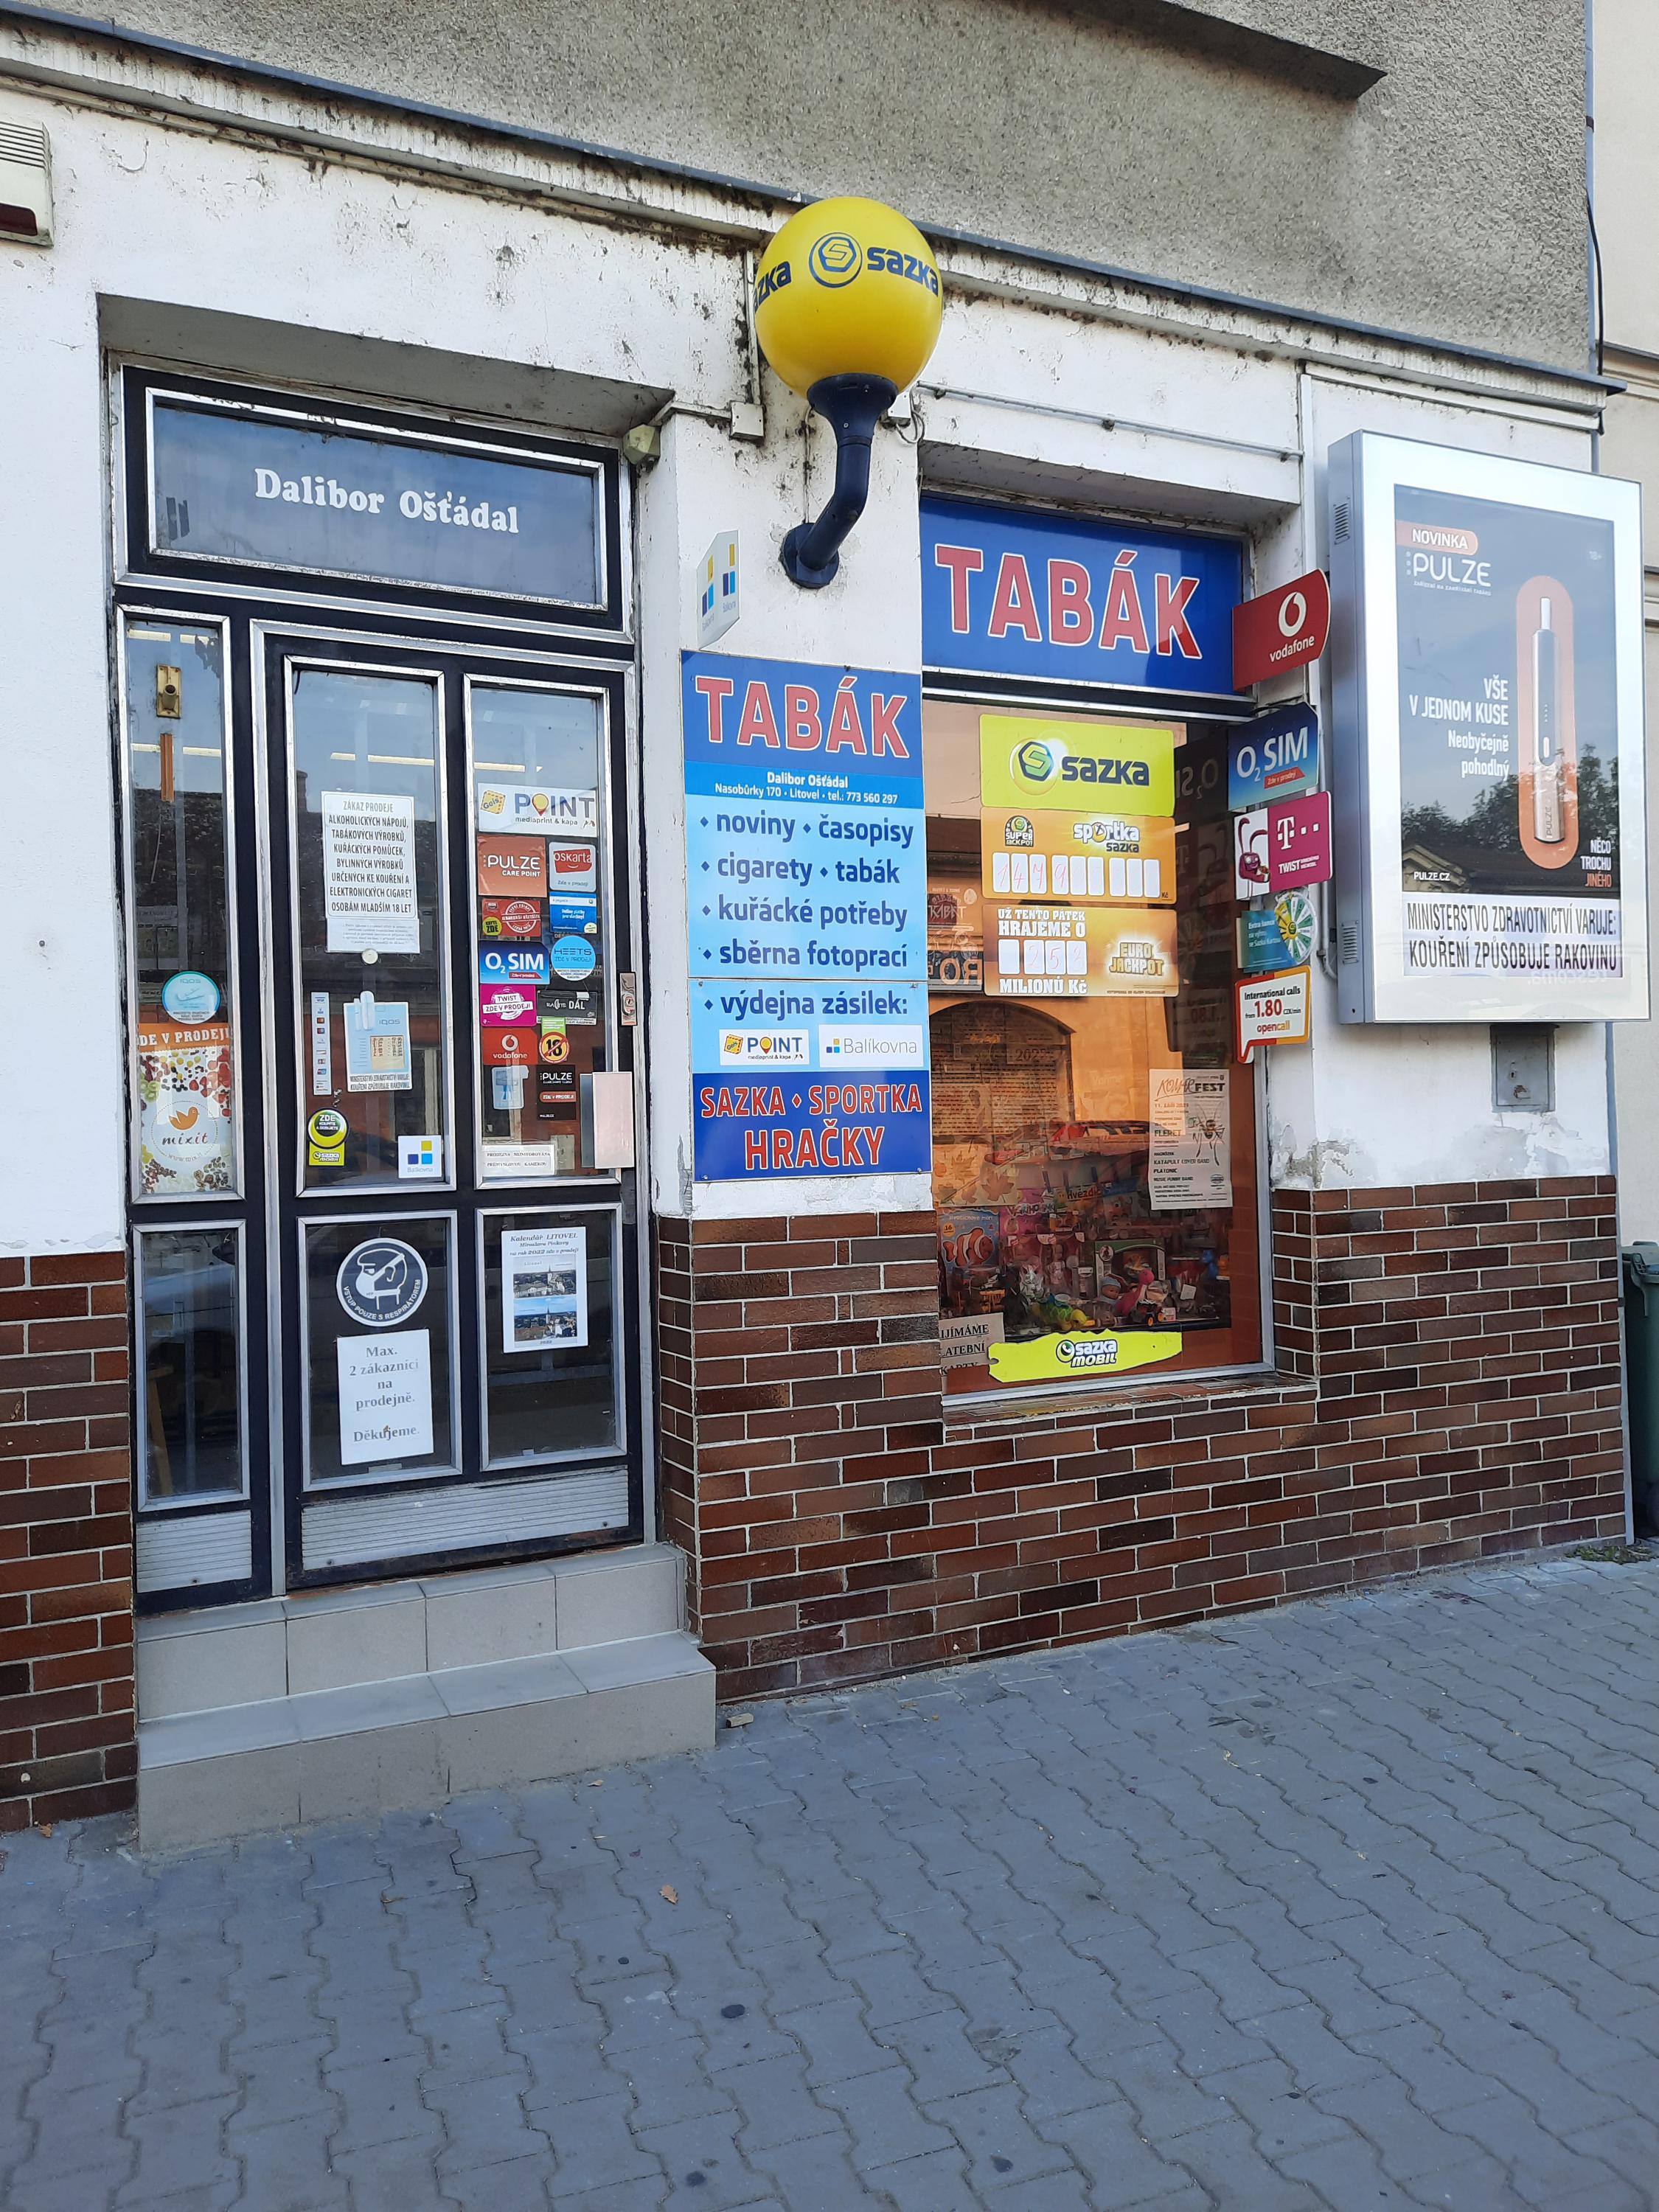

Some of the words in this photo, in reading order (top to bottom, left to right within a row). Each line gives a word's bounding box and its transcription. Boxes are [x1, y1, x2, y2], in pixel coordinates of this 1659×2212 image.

[254, 467, 385, 515] Dalibor
[399, 490, 519, 534] Ošťádal
[1412, 529, 1468, 549] NOVINKA
[1413, 552, 1492, 587] PULZE
[934, 543, 1203, 659] TABÁK
[1270, 636, 1315, 662] vodafone
[1484, 674, 1509, 700] VŠE
[695, 675, 910, 758] TABÁK
[1409, 695, 1419, 716] V
[1422, 697, 1472, 722] JEDNOM
[1475, 703, 1509, 726] KUSE
[1264, 726, 1308, 771] SIM
[1448, 730, 1509, 755] Neobyčejně
[1461, 758, 1509, 778] pohodlný
[767, 771, 807, 786] Dalibor
[808, 774, 848, 788] Ošťádal
[715, 783, 764, 799] Nasobůrky
[766, 786, 782, 797] 170
[790, 789, 819, 800] Litovel
[846, 792, 861, 801] 773
[863, 793, 880, 803] 560
[882, 793, 898, 804] 297
[344, 801, 364, 811] ZÁKAZ
[366, 802, 394, 813] PRODEJE
[328, 815, 380, 827] ALKOHOLICKÝCH
[716, 809, 796, 843] noviny
[818, 813, 914, 849] časopisy
[332, 829, 373, 841] TABÁKOVÝCH
[333, 843, 371, 854] KUŘÁCKÝCH
[1590, 836, 1611, 854] NĚCO
[336, 858, 372, 869] BYLINNÝCH
[374, 859, 403, 869] VÝROBKŮ
[487, 855, 540, 870] PULZE
[717, 851, 813, 886] cigarety
[835, 857, 900, 884] tabák
[1279, 859, 1301, 874] TWIST
[1580, 855, 1612, 871] TROCHU
[332, 872, 365, 883] URČENÝCH
[366, 874, 375, 883] KE
[376, 874, 404, 883] KOUŘENÍ
[1413, 871, 1451, 881] PULZE.CZ
[1585, 873, 1612, 888] JINÉHO
[330, 886, 384, 897] ELEKTRONICKÝCH
[386, 888, 411, 898] CIGARET
[332, 901, 359, 911] OSOBÁM
[361, 902, 391, 912] MLADŠÍM
[393, 904, 400, 912] 18
[401, 904, 411, 913] LET
[719, 894, 813, 922] kuřácké
[820, 900, 908, 932] potřeby
[998, 907, 1012, 919] UŽ
[1015, 909, 1050, 920] TENTO
[1052, 908, 1085, 921] PÁTEK
[1408, 902, 1489, 932] MINISTERSTVO
[1492, 902, 1573, 935] ZDRAVOTNICTVÍ
[1576, 909, 1616, 935] VARUJE:
[998, 920, 1071, 936] HRAJEME
[1076, 922, 1085, 937] O
[720, 938, 800, 965] sběrna
[807, 939, 908, 972] fotoprací
[1119, 942, 1153, 958] EURO
[1410, 935, 1470, 968] KOUŘENÍ
[1475, 936, 1550, 969] ZPŮSOBUJE
[1555, 944, 1617, 971] RAKOVINU
[507, 953, 543, 970] SIM
[1109, 956, 1164, 976] JACKPOT
[1000, 975, 1063, 993] MILIONŮ
[1068, 979, 1087, 994] Kč
[1245, 987, 1285, 1000] International
[1286, 986, 1301, 995] calls
[720, 989, 814, 1021] výdejna
[821, 990, 908, 1015] zásilek:
[1254, 999, 1282, 1018] 1.80
[1257, 1020, 1290, 1034] opencall
[161, 1033, 170, 1044] V
[844, 1037, 917, 1054] Balíkovna
[543, 1072, 572, 1080] PULZE
[1194, 1083, 1225, 1092] FEST
[700, 1085, 786, 1119] SAZKA
[808, 1083, 922, 1116] SPORTKA
[745, 1119, 884, 1170] HRAČKY
[344, 1286, 356, 1307] VSTUP
[355, 1306, 377, 1320] POUZE
[366, 1346, 397, 1358] Max.
[1071, 1353, 1116, 1367] MOBIL
[349, 1366, 356, 1376] 2
[361, 1358, 419, 1375] zákazníci
[378, 1380, 392, 1390] na
[355, 1392, 415, 1411] prodejně.
[354, 1426, 420, 1442] Děkujeme.
